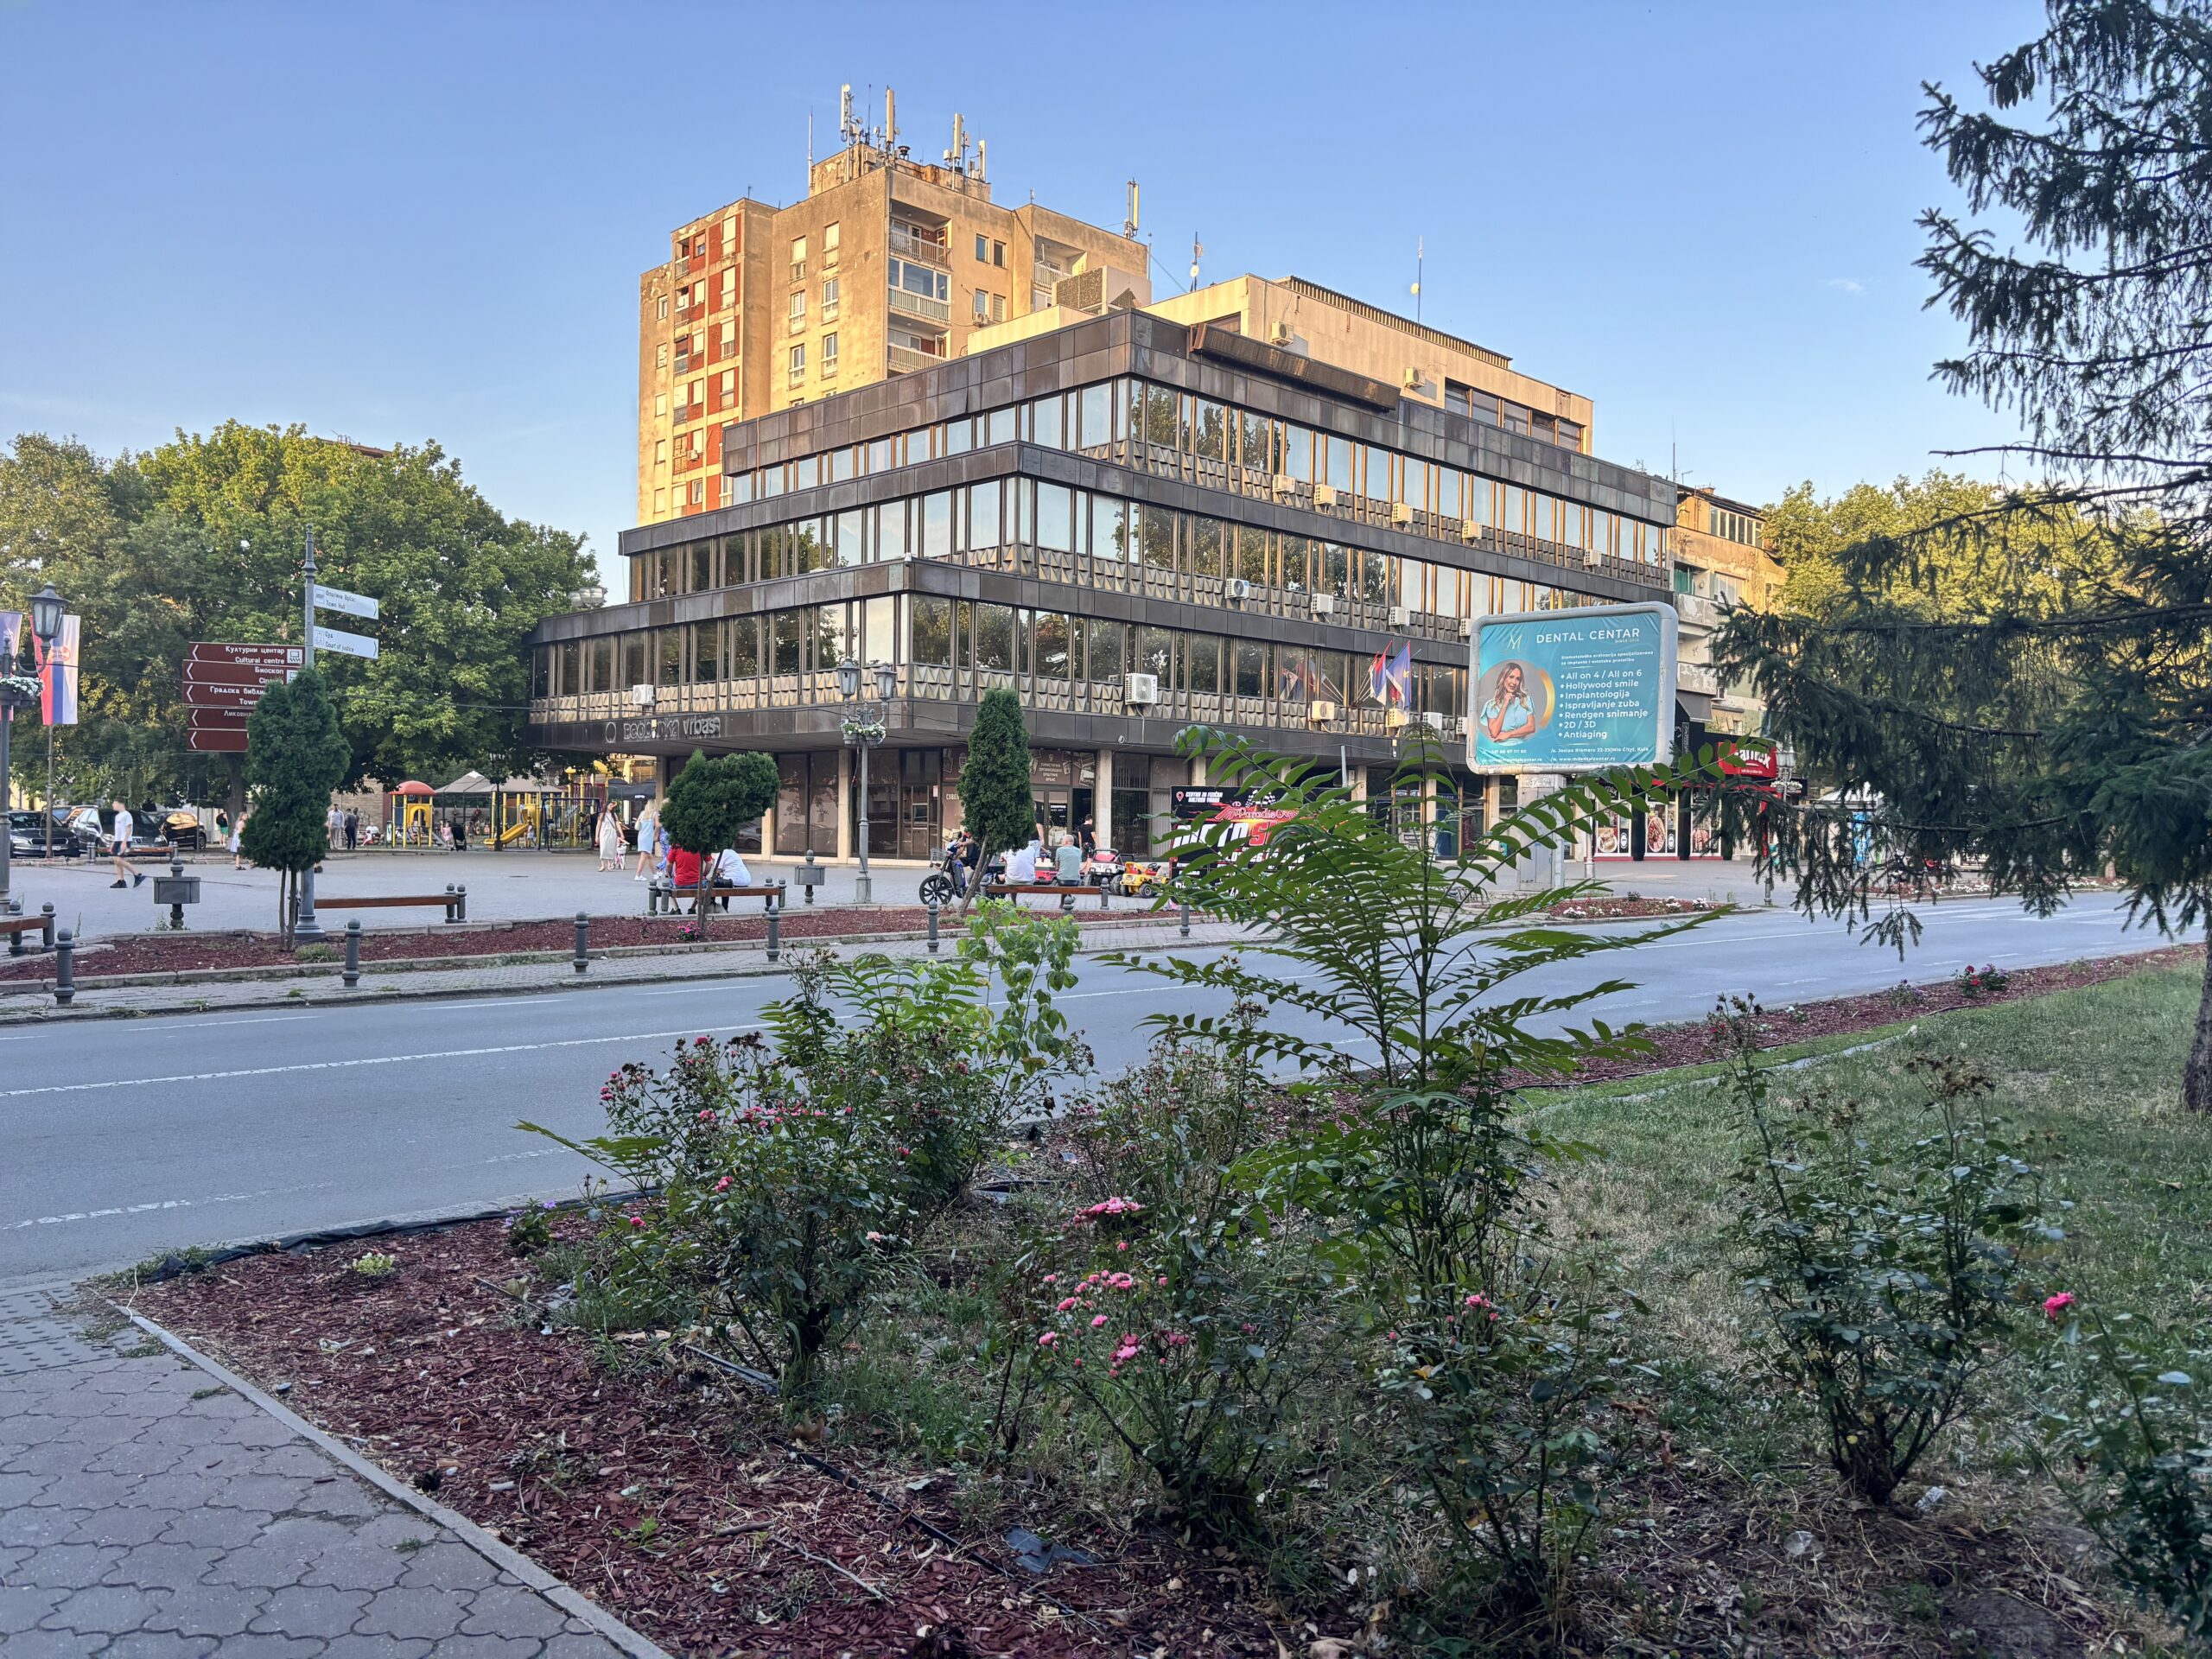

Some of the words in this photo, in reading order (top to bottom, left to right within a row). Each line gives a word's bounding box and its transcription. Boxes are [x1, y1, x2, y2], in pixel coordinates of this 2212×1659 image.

[1536, 632, 1585, 644] DENTAL
[1589, 627, 1640, 639] CENTAR
[226, 645, 257, 656] Културни
[341, 645, 354, 653] justice
[255, 666, 284, 675] Биоскоп
[1566, 671, 1578, 680] All
[1607, 670, 1620, 678] All
[1636, 669, 1643, 677] 6
[1566, 680, 1612, 690] Hollywood
[1614, 679, 1639, 688] smile
[210, 686, 239, 695] Градска
[1565, 690, 1630, 701] Implantologija
[1565, 701, 1616, 711] Ispravljanje
[1564, 710, 1605, 720] Rendgen
[1606, 709, 1648, 719] snimanje
[1564, 721, 1576, 729] 2D
[1563, 730, 1608, 740] Antiaging
